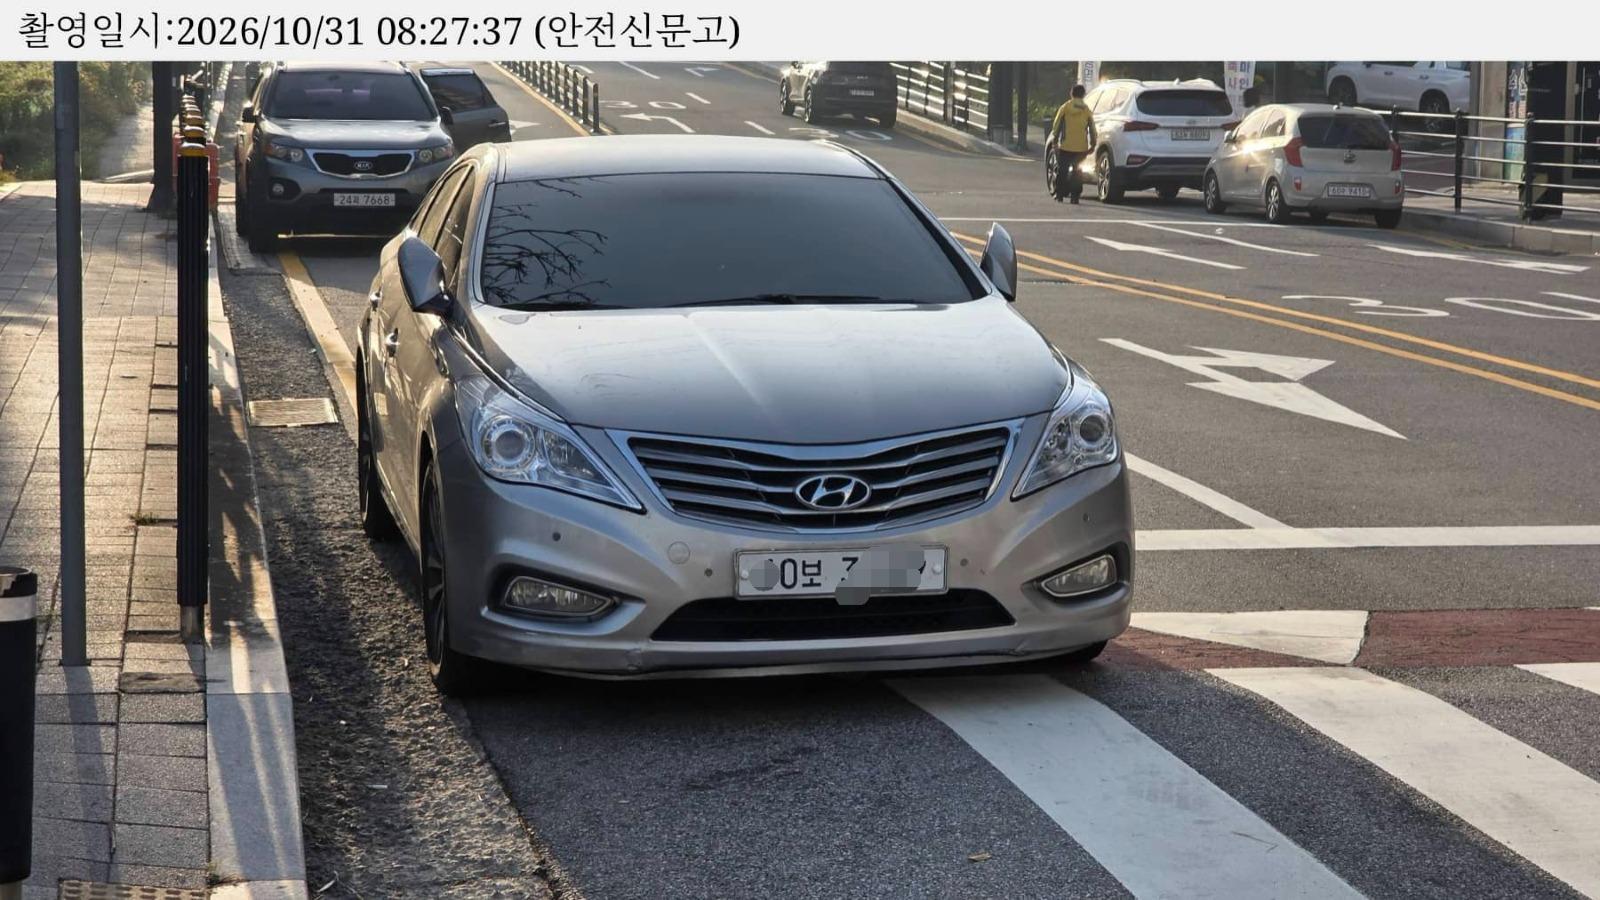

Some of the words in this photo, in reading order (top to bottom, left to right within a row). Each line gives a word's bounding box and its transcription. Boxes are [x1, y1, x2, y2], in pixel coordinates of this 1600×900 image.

[599, 100, 687, 110] 30
[363, 195, 390, 205] 7668
[754, 557, 822, 590] 0보
